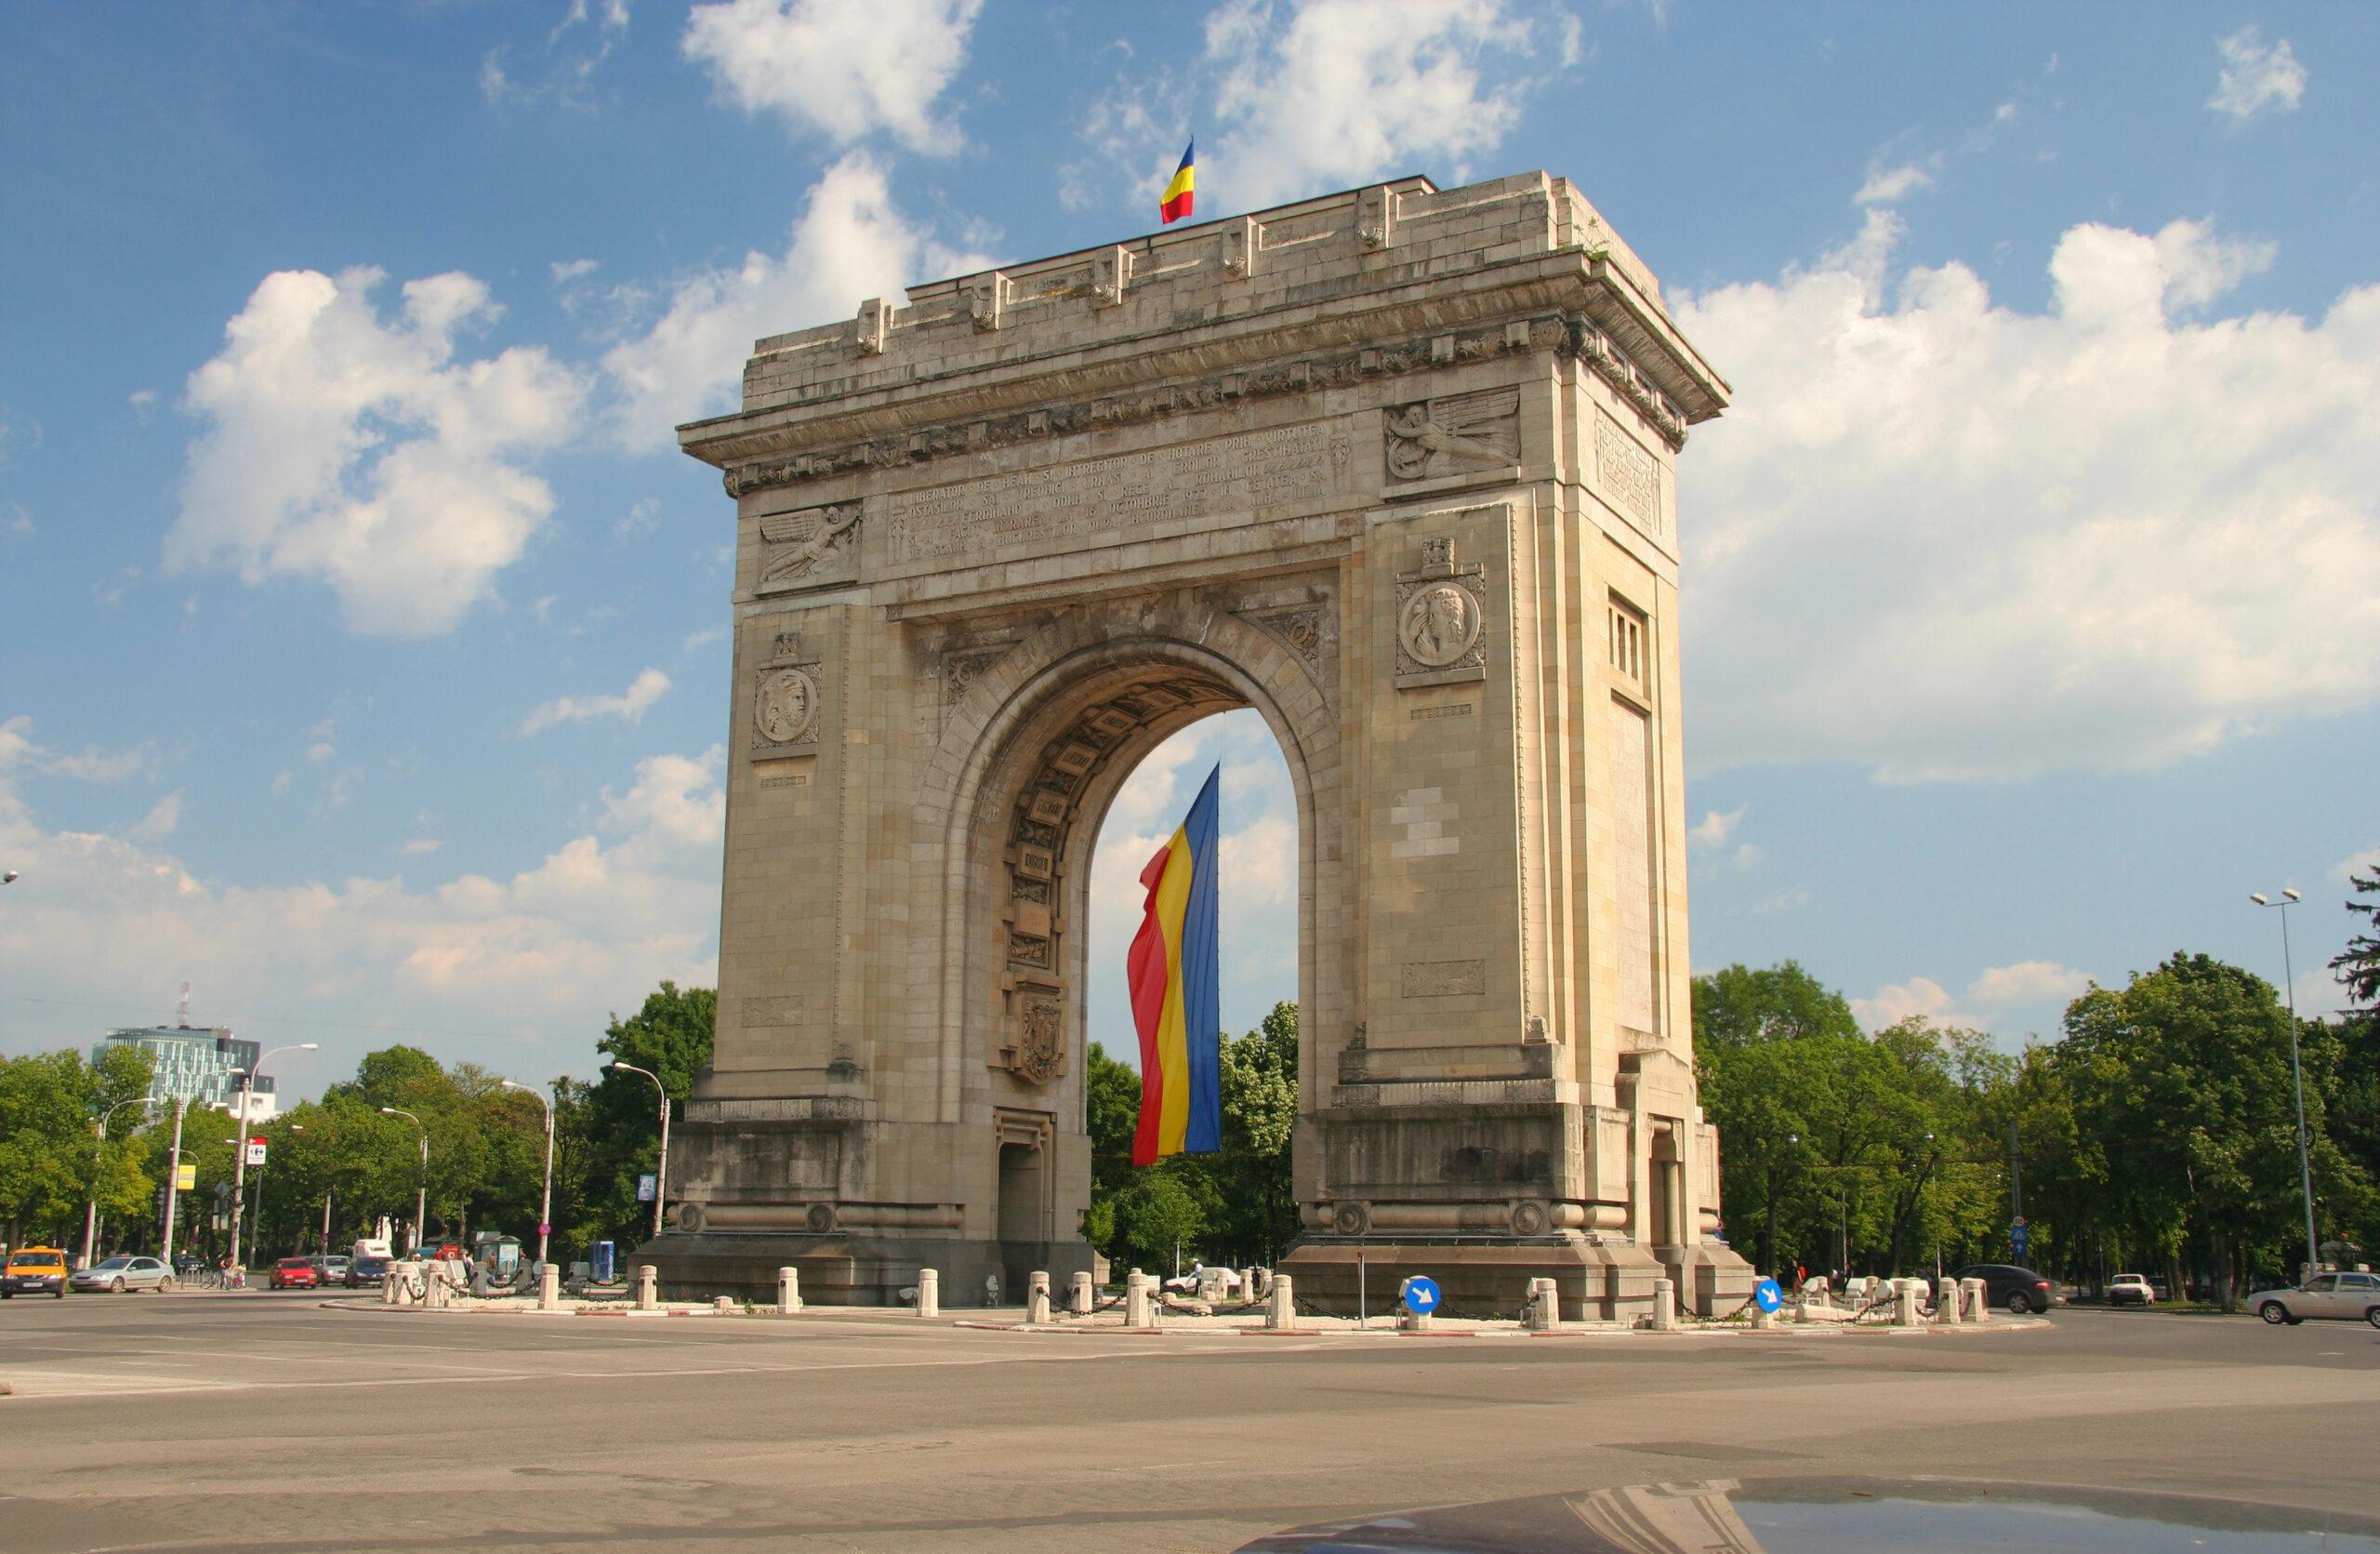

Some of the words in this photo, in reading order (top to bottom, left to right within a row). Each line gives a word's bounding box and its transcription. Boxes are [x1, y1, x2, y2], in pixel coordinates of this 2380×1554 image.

[909, 484, 965, 504] LIBERATOR
[976, 479, 990, 492] DE
[1139, 451, 1155, 465] DE
[1168, 442, 1211, 460] HOTARE
[1225, 434, 1250, 451] PRIN
[1264, 422, 1324, 444] VIRTUTEA
